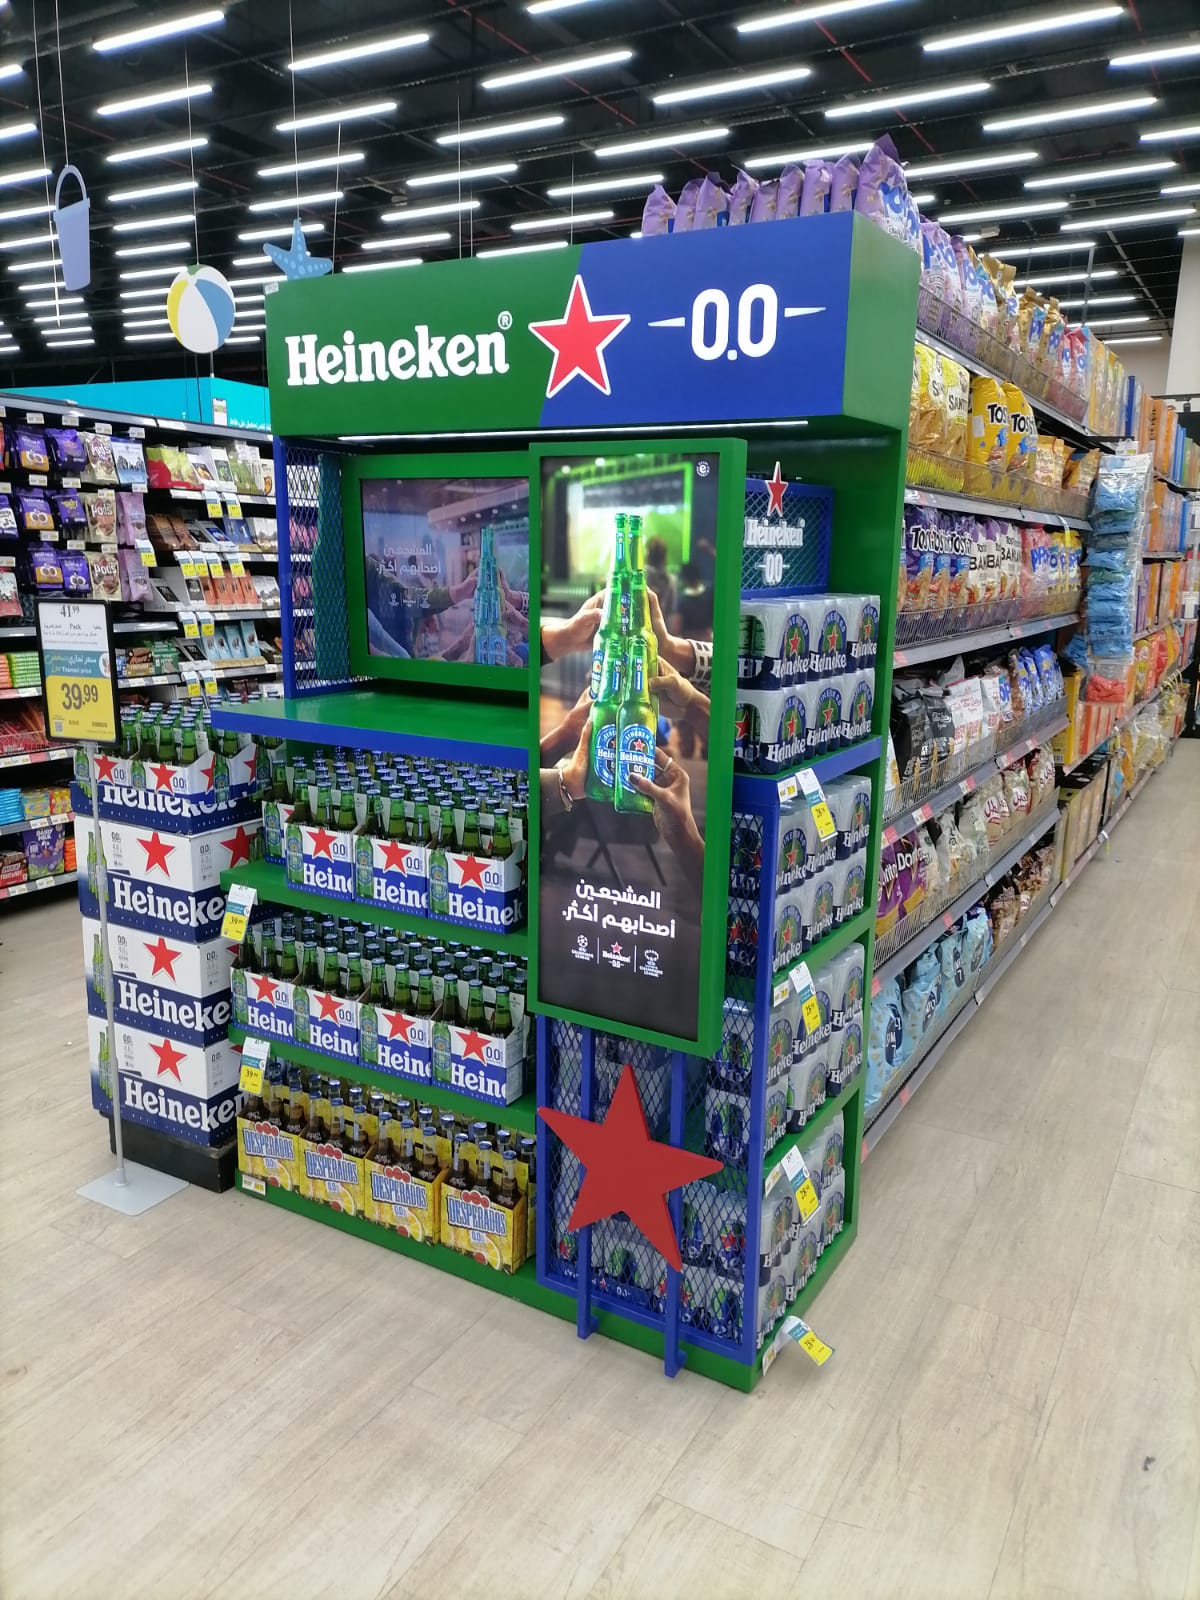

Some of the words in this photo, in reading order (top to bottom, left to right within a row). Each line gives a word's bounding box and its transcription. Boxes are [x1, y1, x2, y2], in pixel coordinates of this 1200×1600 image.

[690, 283, 779, 362] 0.0
[61, 683, 98, 710] 39.99
[172, 776, 186, 789] 0.0
[332, 842, 346, 856] 0.0
[406, 856, 420, 871] 0.0
[485, 871, 499, 886] 0.0
[112, 877, 226, 928] Heineke
[575, 878, 661, 910] المشجعين
[274, 989, 288, 1003] 0.0
[338, 1008, 352, 1022] 0.0
[410, 1027, 424, 1042] 0.0
[485, 1046, 500, 1062] 0.0
[244, 1130, 294, 1159] DESPERADOS
[306, 1152, 358, 1184] DESPERADOS
[372, 1173, 427, 1209] DESPERADOS
[448, 1197, 507, 1235] DESPERADOS
